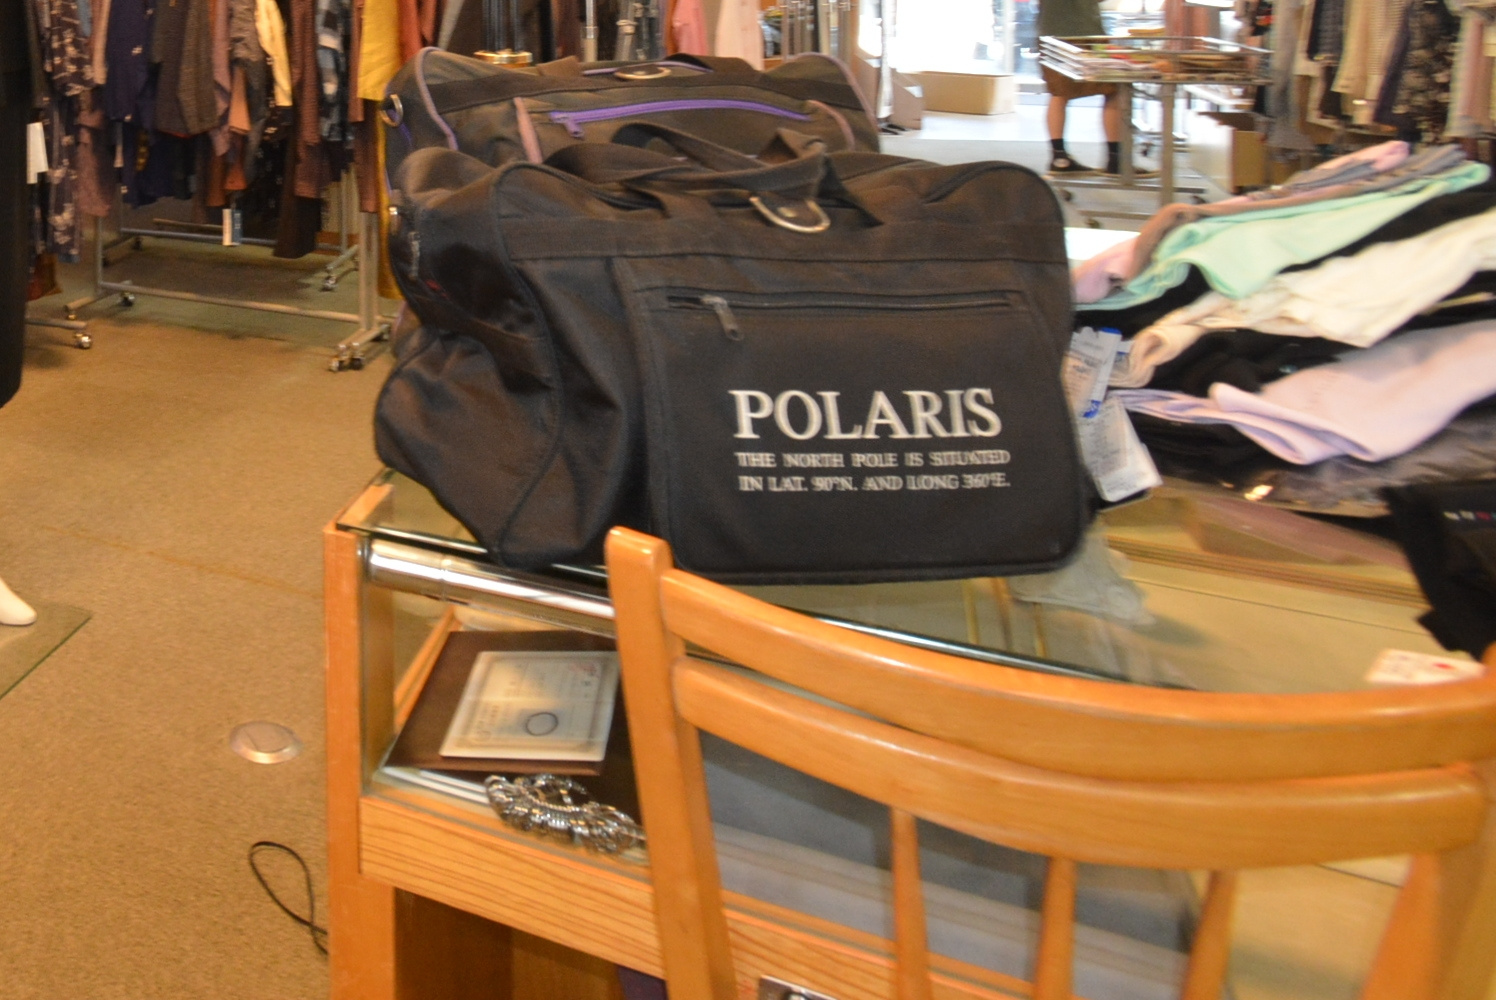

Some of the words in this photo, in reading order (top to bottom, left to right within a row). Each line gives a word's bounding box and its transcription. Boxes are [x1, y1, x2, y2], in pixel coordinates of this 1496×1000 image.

[728, 388, 1003, 441] POLARIS
[734, 452, 777, 468] THE
[782, 453, 845, 468] NORTH
[850, 453, 899, 468] POLE
[904, 452, 924, 467] IS
[928, 449, 1011, 467] SITUATED
[738, 476, 764, 492] IN
[861, 475, 904, 491] AND
